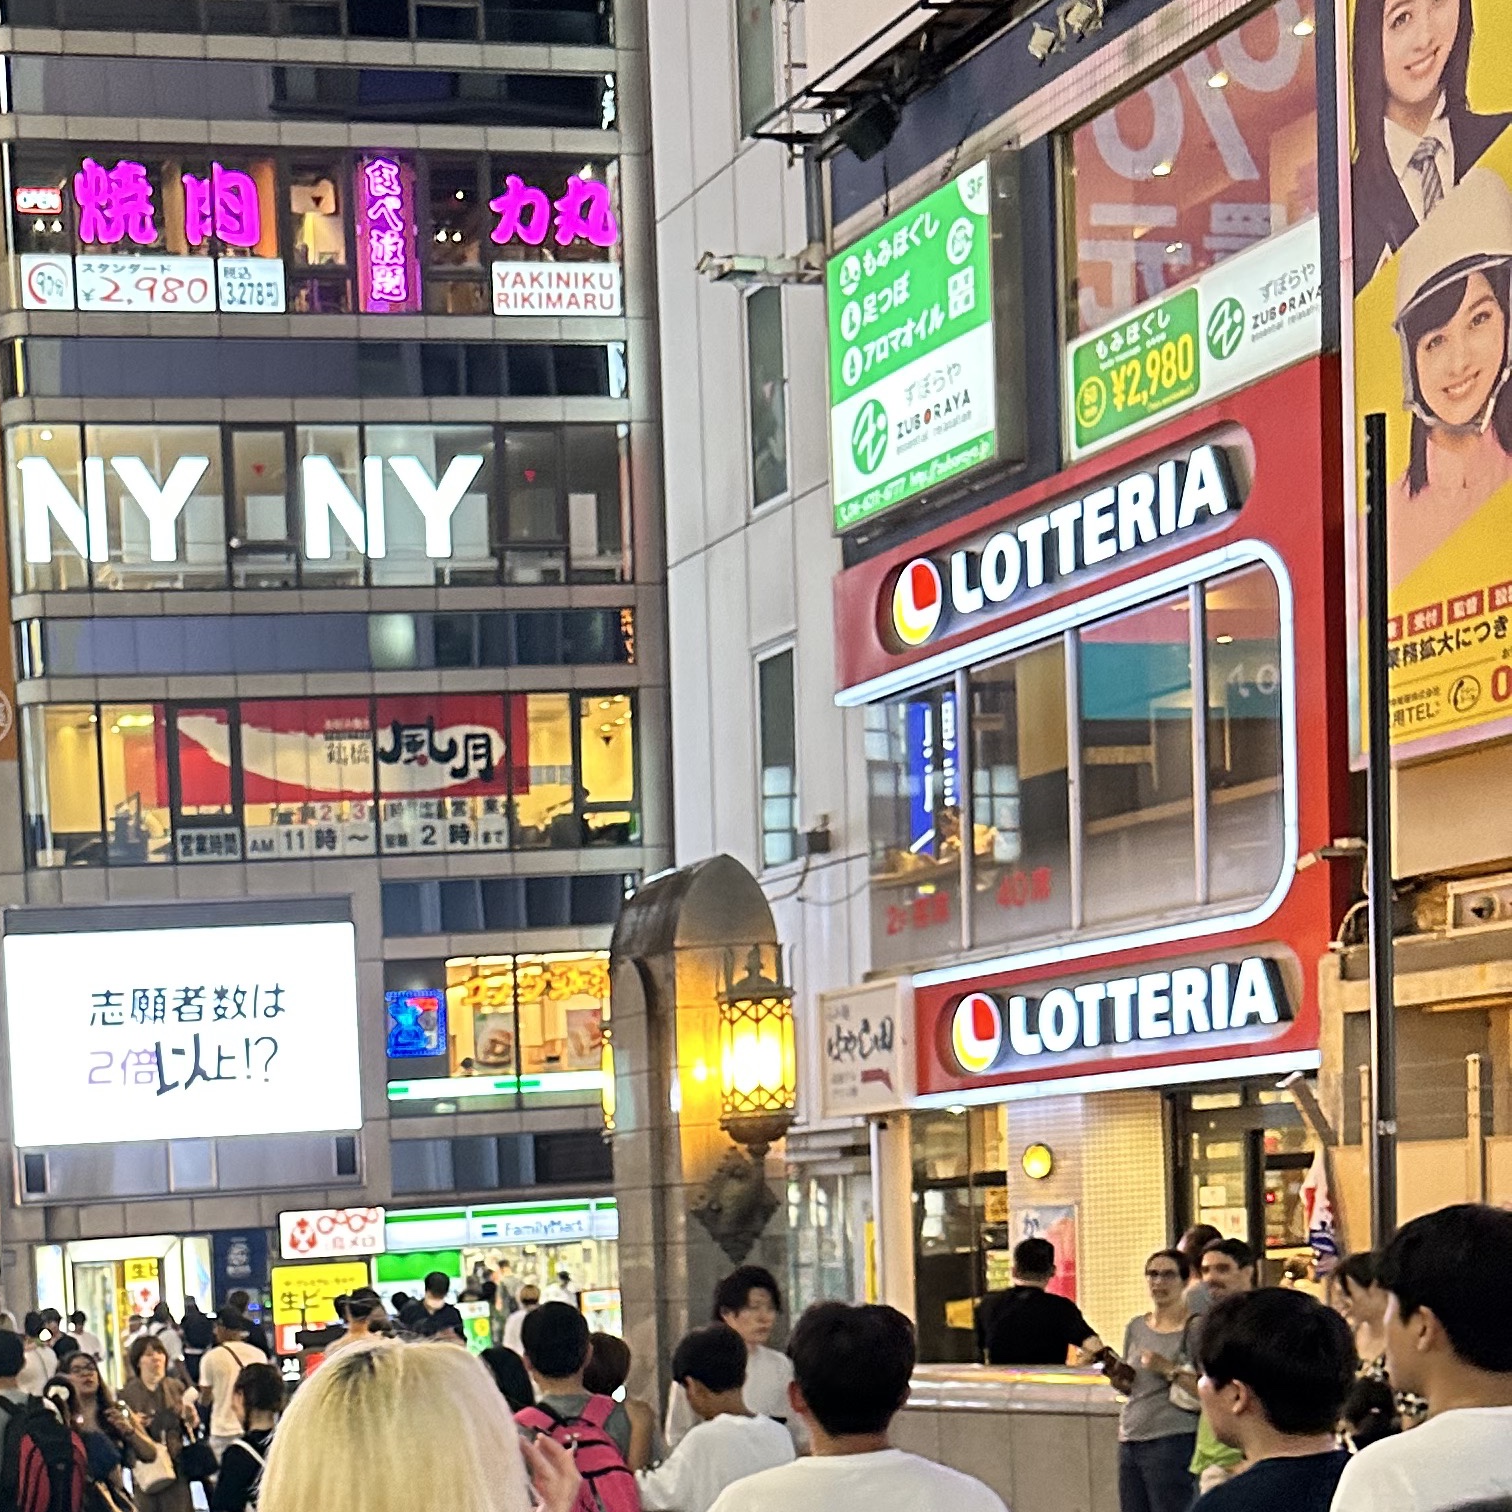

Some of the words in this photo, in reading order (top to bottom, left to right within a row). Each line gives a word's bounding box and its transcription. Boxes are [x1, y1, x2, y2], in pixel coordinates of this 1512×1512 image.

[74, 157, 262, 248] 焼肉
[489, 173, 618, 247] 力丸
[82, 262, 172, 274] スタンダード
[862, 211, 940, 278] もみほぐし
[496, 271, 614, 290] YAKINIKU
[496, 291, 615, 310] RIKIMARU
[862, 304, 946, 373] アロマオイル
[1110, 333, 1195, 413] ¥2,980
[896, 388, 971, 440] ZUBORAYA
[22, 455, 210, 564] NY
[302, 453, 485, 560] NY
[950, 444, 1229, 614] LOTTERIA
[376, 714, 494, 783] 風月
[90, 982, 286, 1027] 志願者数は
[1008, 957, 1280, 1056] LOTTERIA
[505, 1218, 583, 1237] FamilyMart
